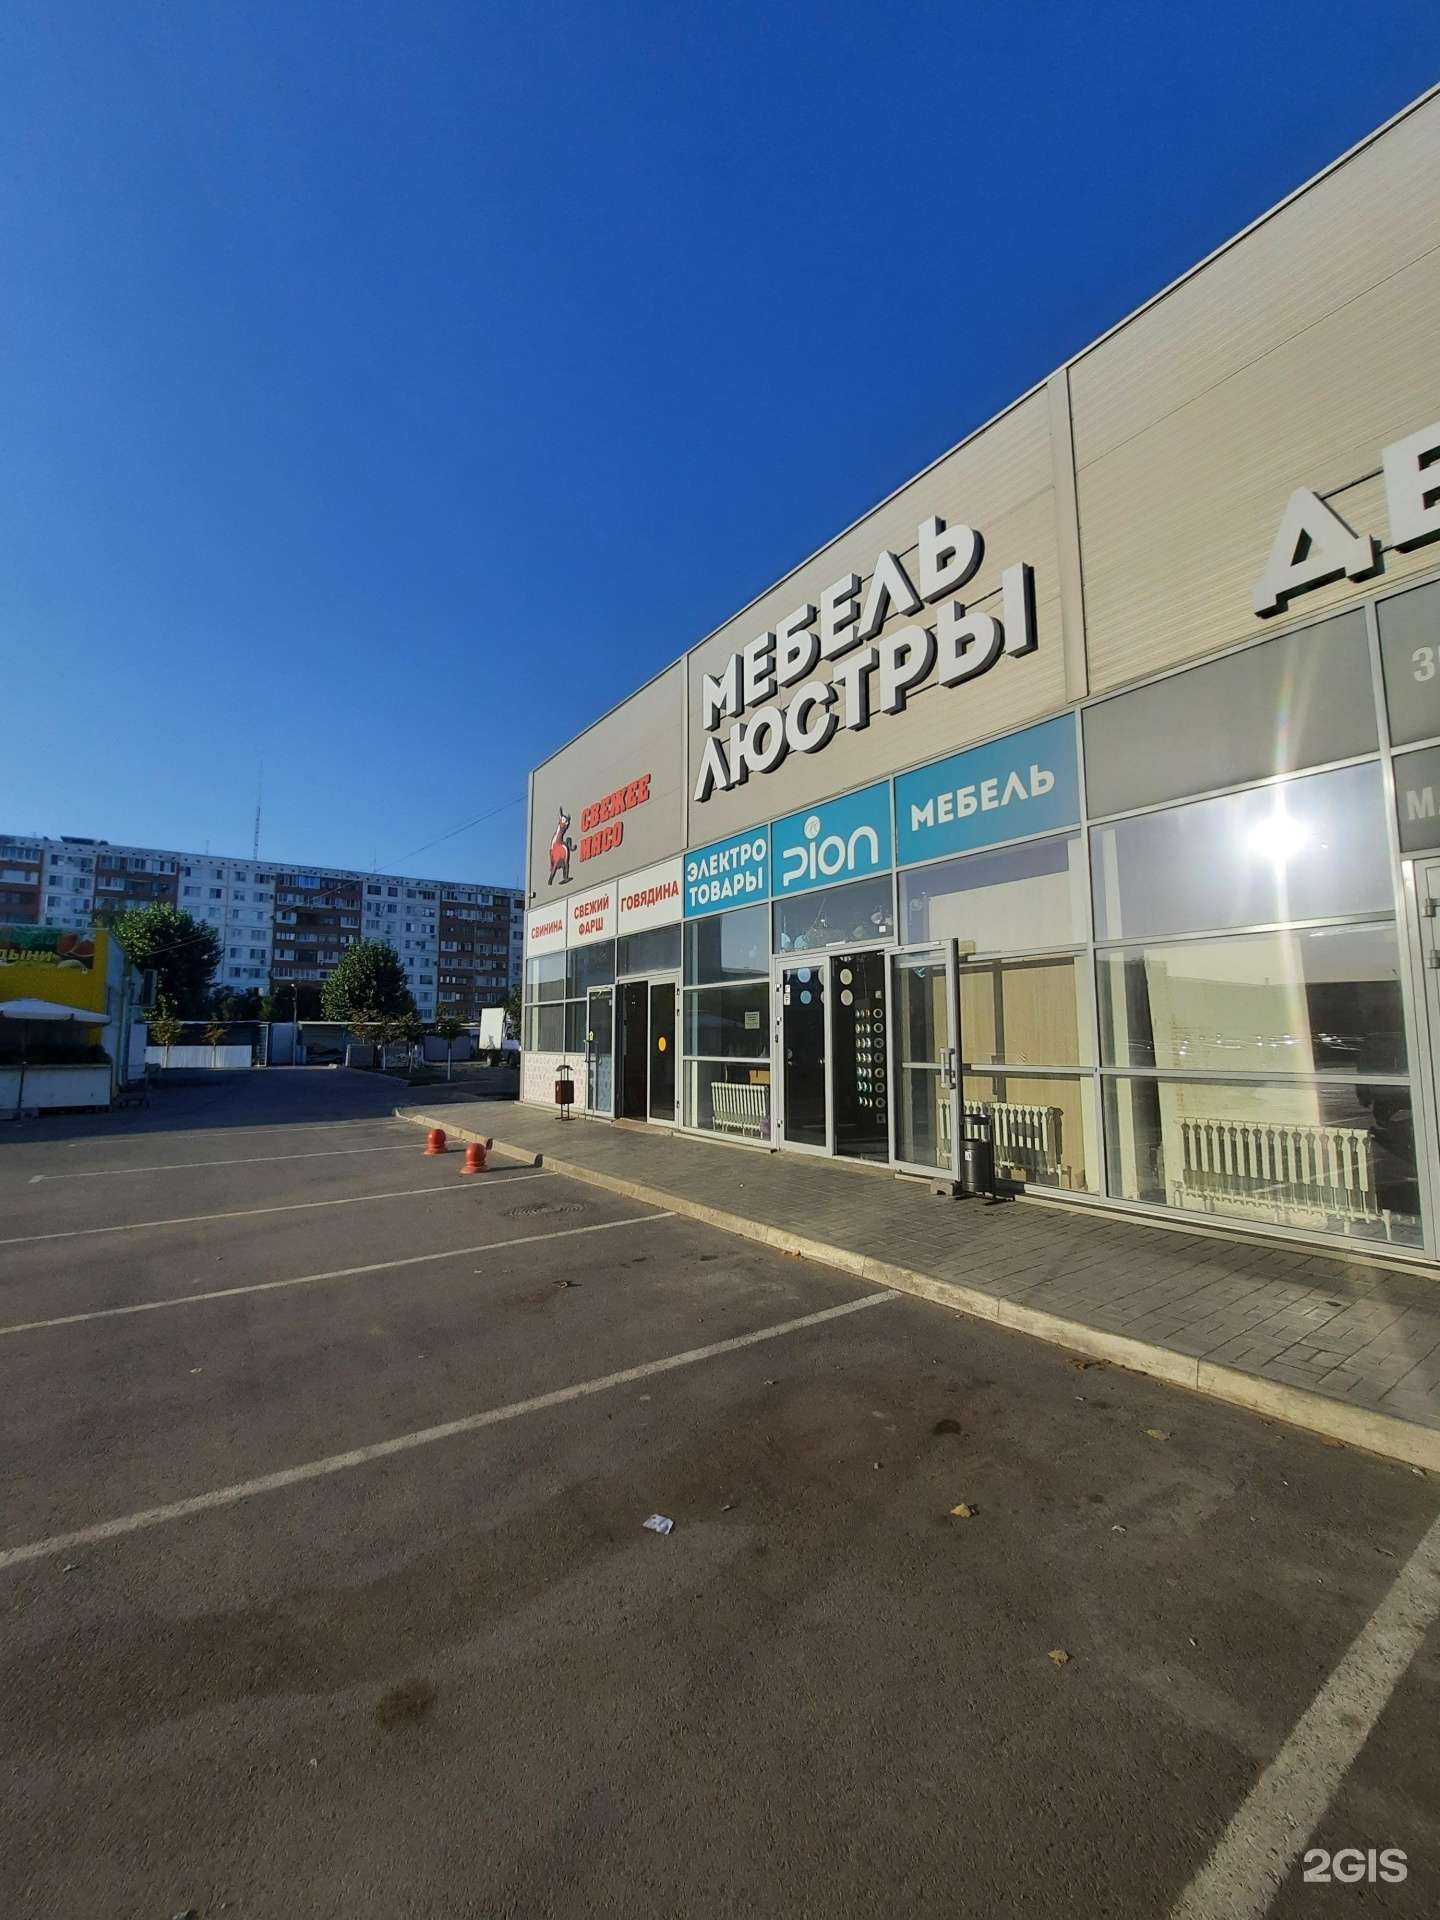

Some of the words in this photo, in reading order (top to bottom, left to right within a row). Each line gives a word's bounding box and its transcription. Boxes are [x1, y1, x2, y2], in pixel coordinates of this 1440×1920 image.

[702, 515, 985, 731] МЕБЕЛЬ
[693, 562, 1039, 803] ЛЮСТРЫ
[580, 773, 652, 833] СВЕЖЕЕ
[910, 764, 1055, 832] МЕБЕЛЬ
[578, 821, 624, 862] МЯСО
[687, 838, 767, 882] ЭЛЕКТРО
[574, 893, 610, 919] СВЕЖИЙ
[620, 880, 679, 913] ГОВЯДИНА
[688, 867, 764, 907] ТОВАРЫ
[531, 919, 563, 940] СВИНИНА
[578, 917, 604, 936] ФАРШ
